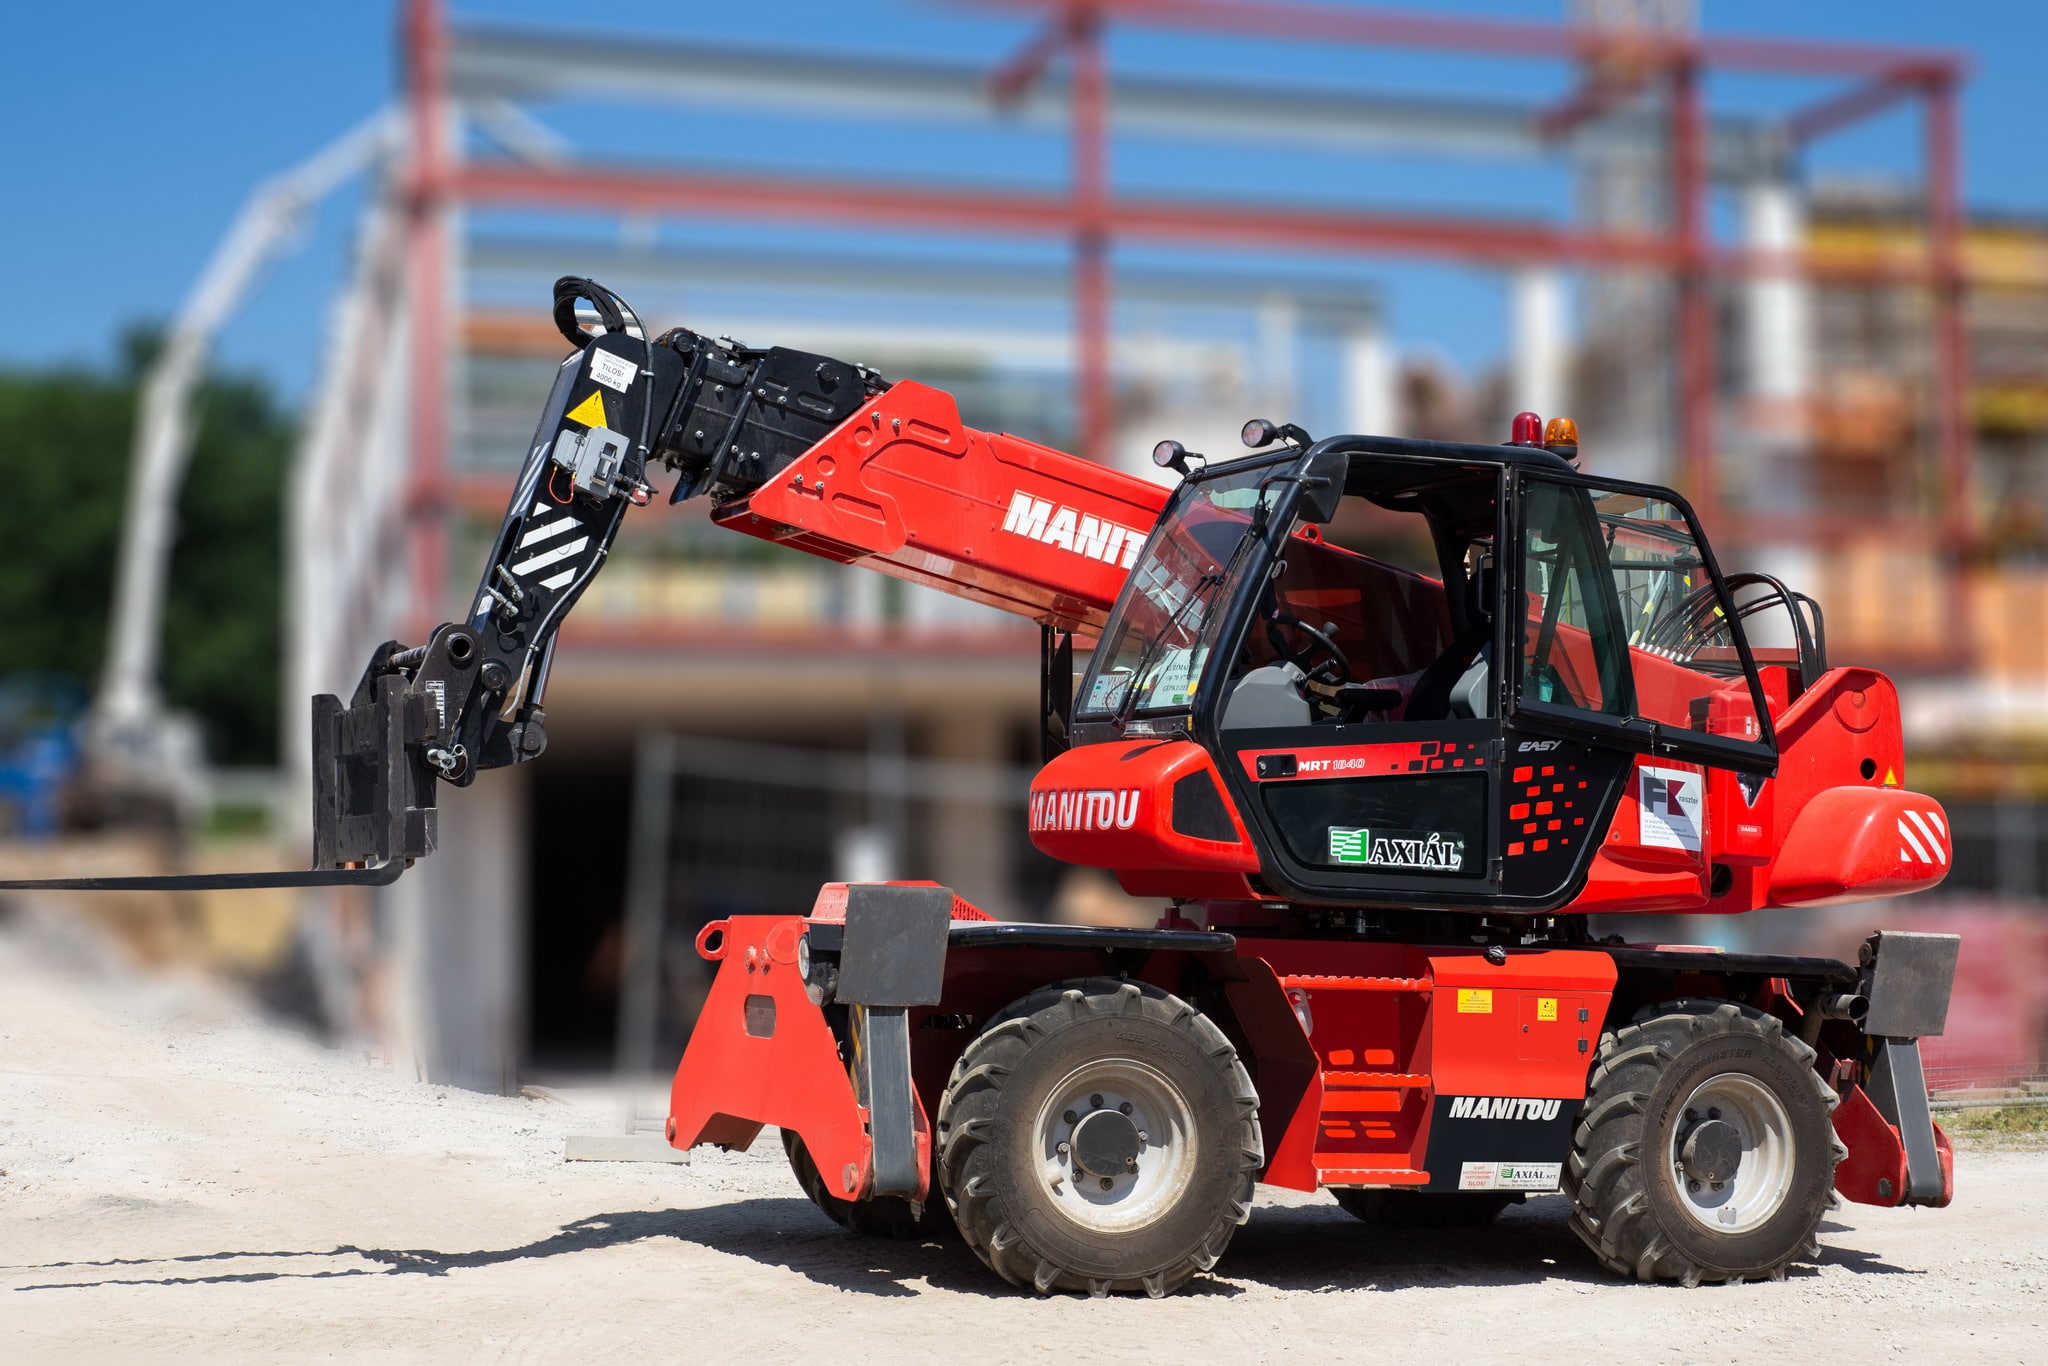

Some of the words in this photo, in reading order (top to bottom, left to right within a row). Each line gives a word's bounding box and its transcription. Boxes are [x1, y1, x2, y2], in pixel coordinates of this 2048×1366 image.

[602, 362, 625, 378] TILOS!
[596, 372, 613, 384] 4000
[612, 379, 622, 390] kg
[1517, 740, 1562, 752] EASY
[1298, 760, 1331, 771] MRT
[1332, 758, 1365, 770] 1840
[1029, 789, 1140, 831] MANITOU
[1368, 832, 1462, 869] AXIÁL
[1448, 1096, 1562, 1121] MANITOU
[1513, 1168, 1545, 1179] AXIÁL
